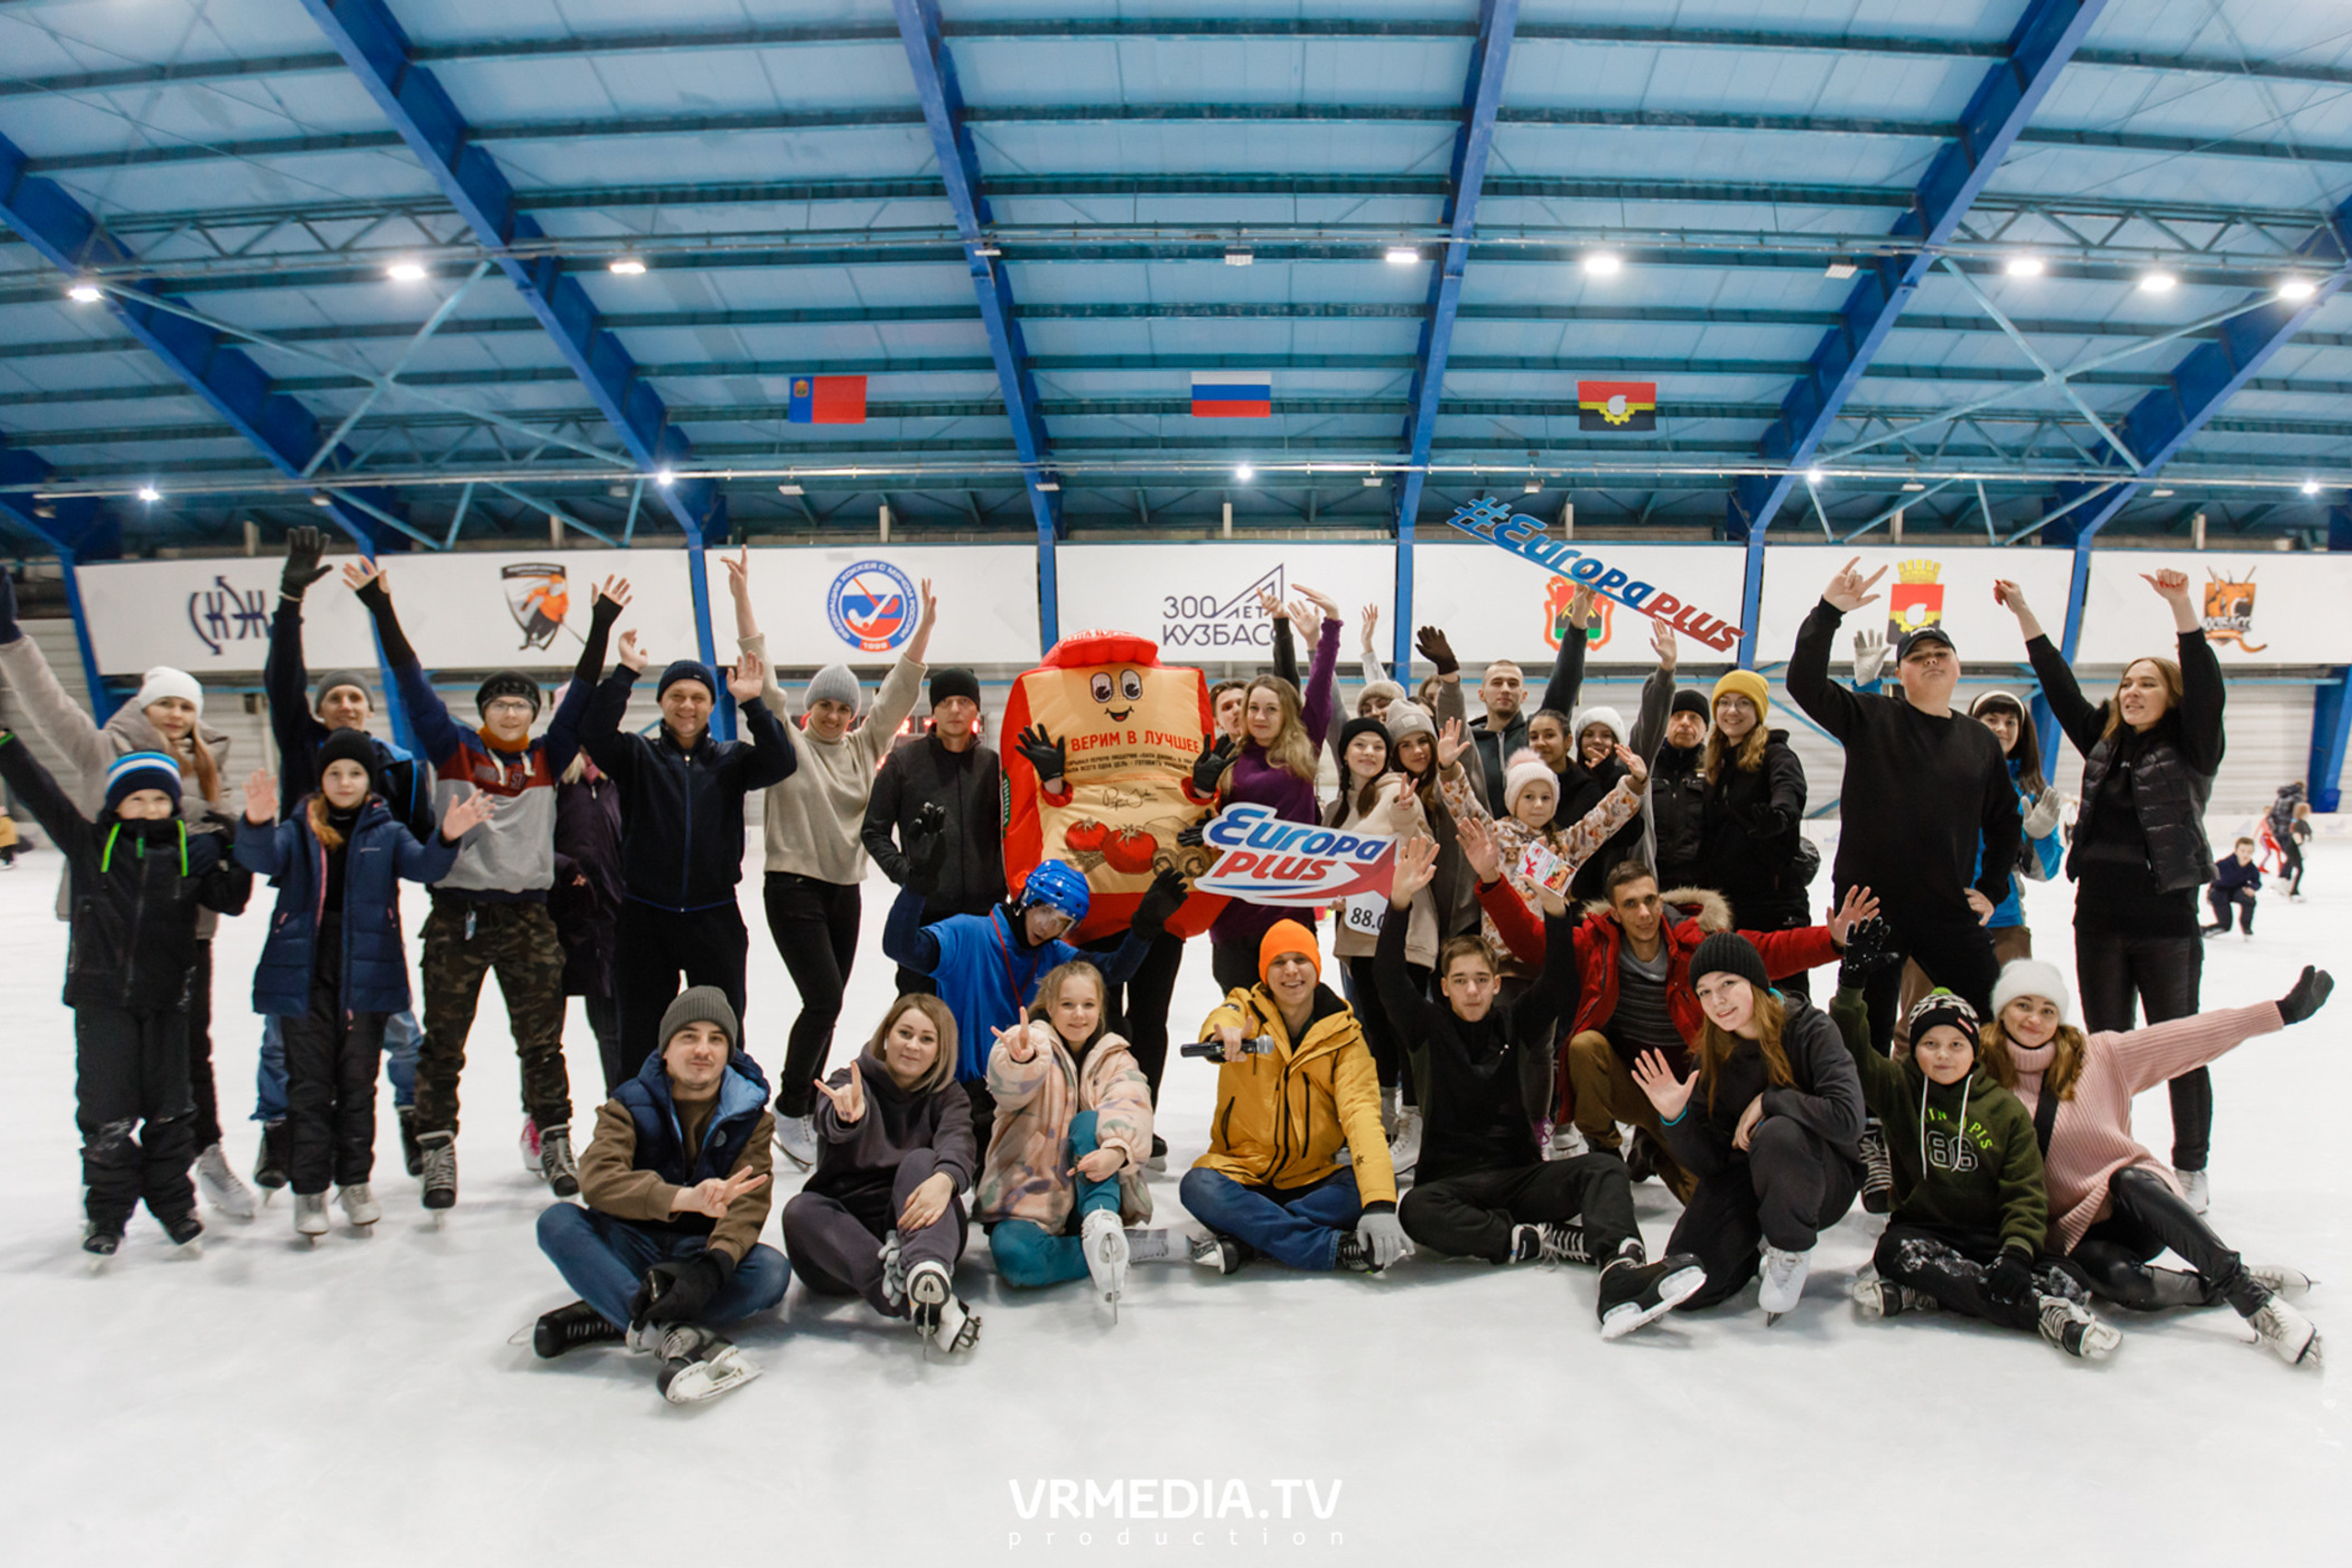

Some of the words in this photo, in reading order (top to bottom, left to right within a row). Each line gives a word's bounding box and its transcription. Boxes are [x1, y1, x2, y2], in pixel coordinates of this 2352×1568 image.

[1163, 595, 1216, 619] 300
[1071, 732, 1120, 752] ВЕРИМ
[1127, 730, 1137, 745] В
[1144, 730, 1201, 754] ЛУЧШЕЕ
